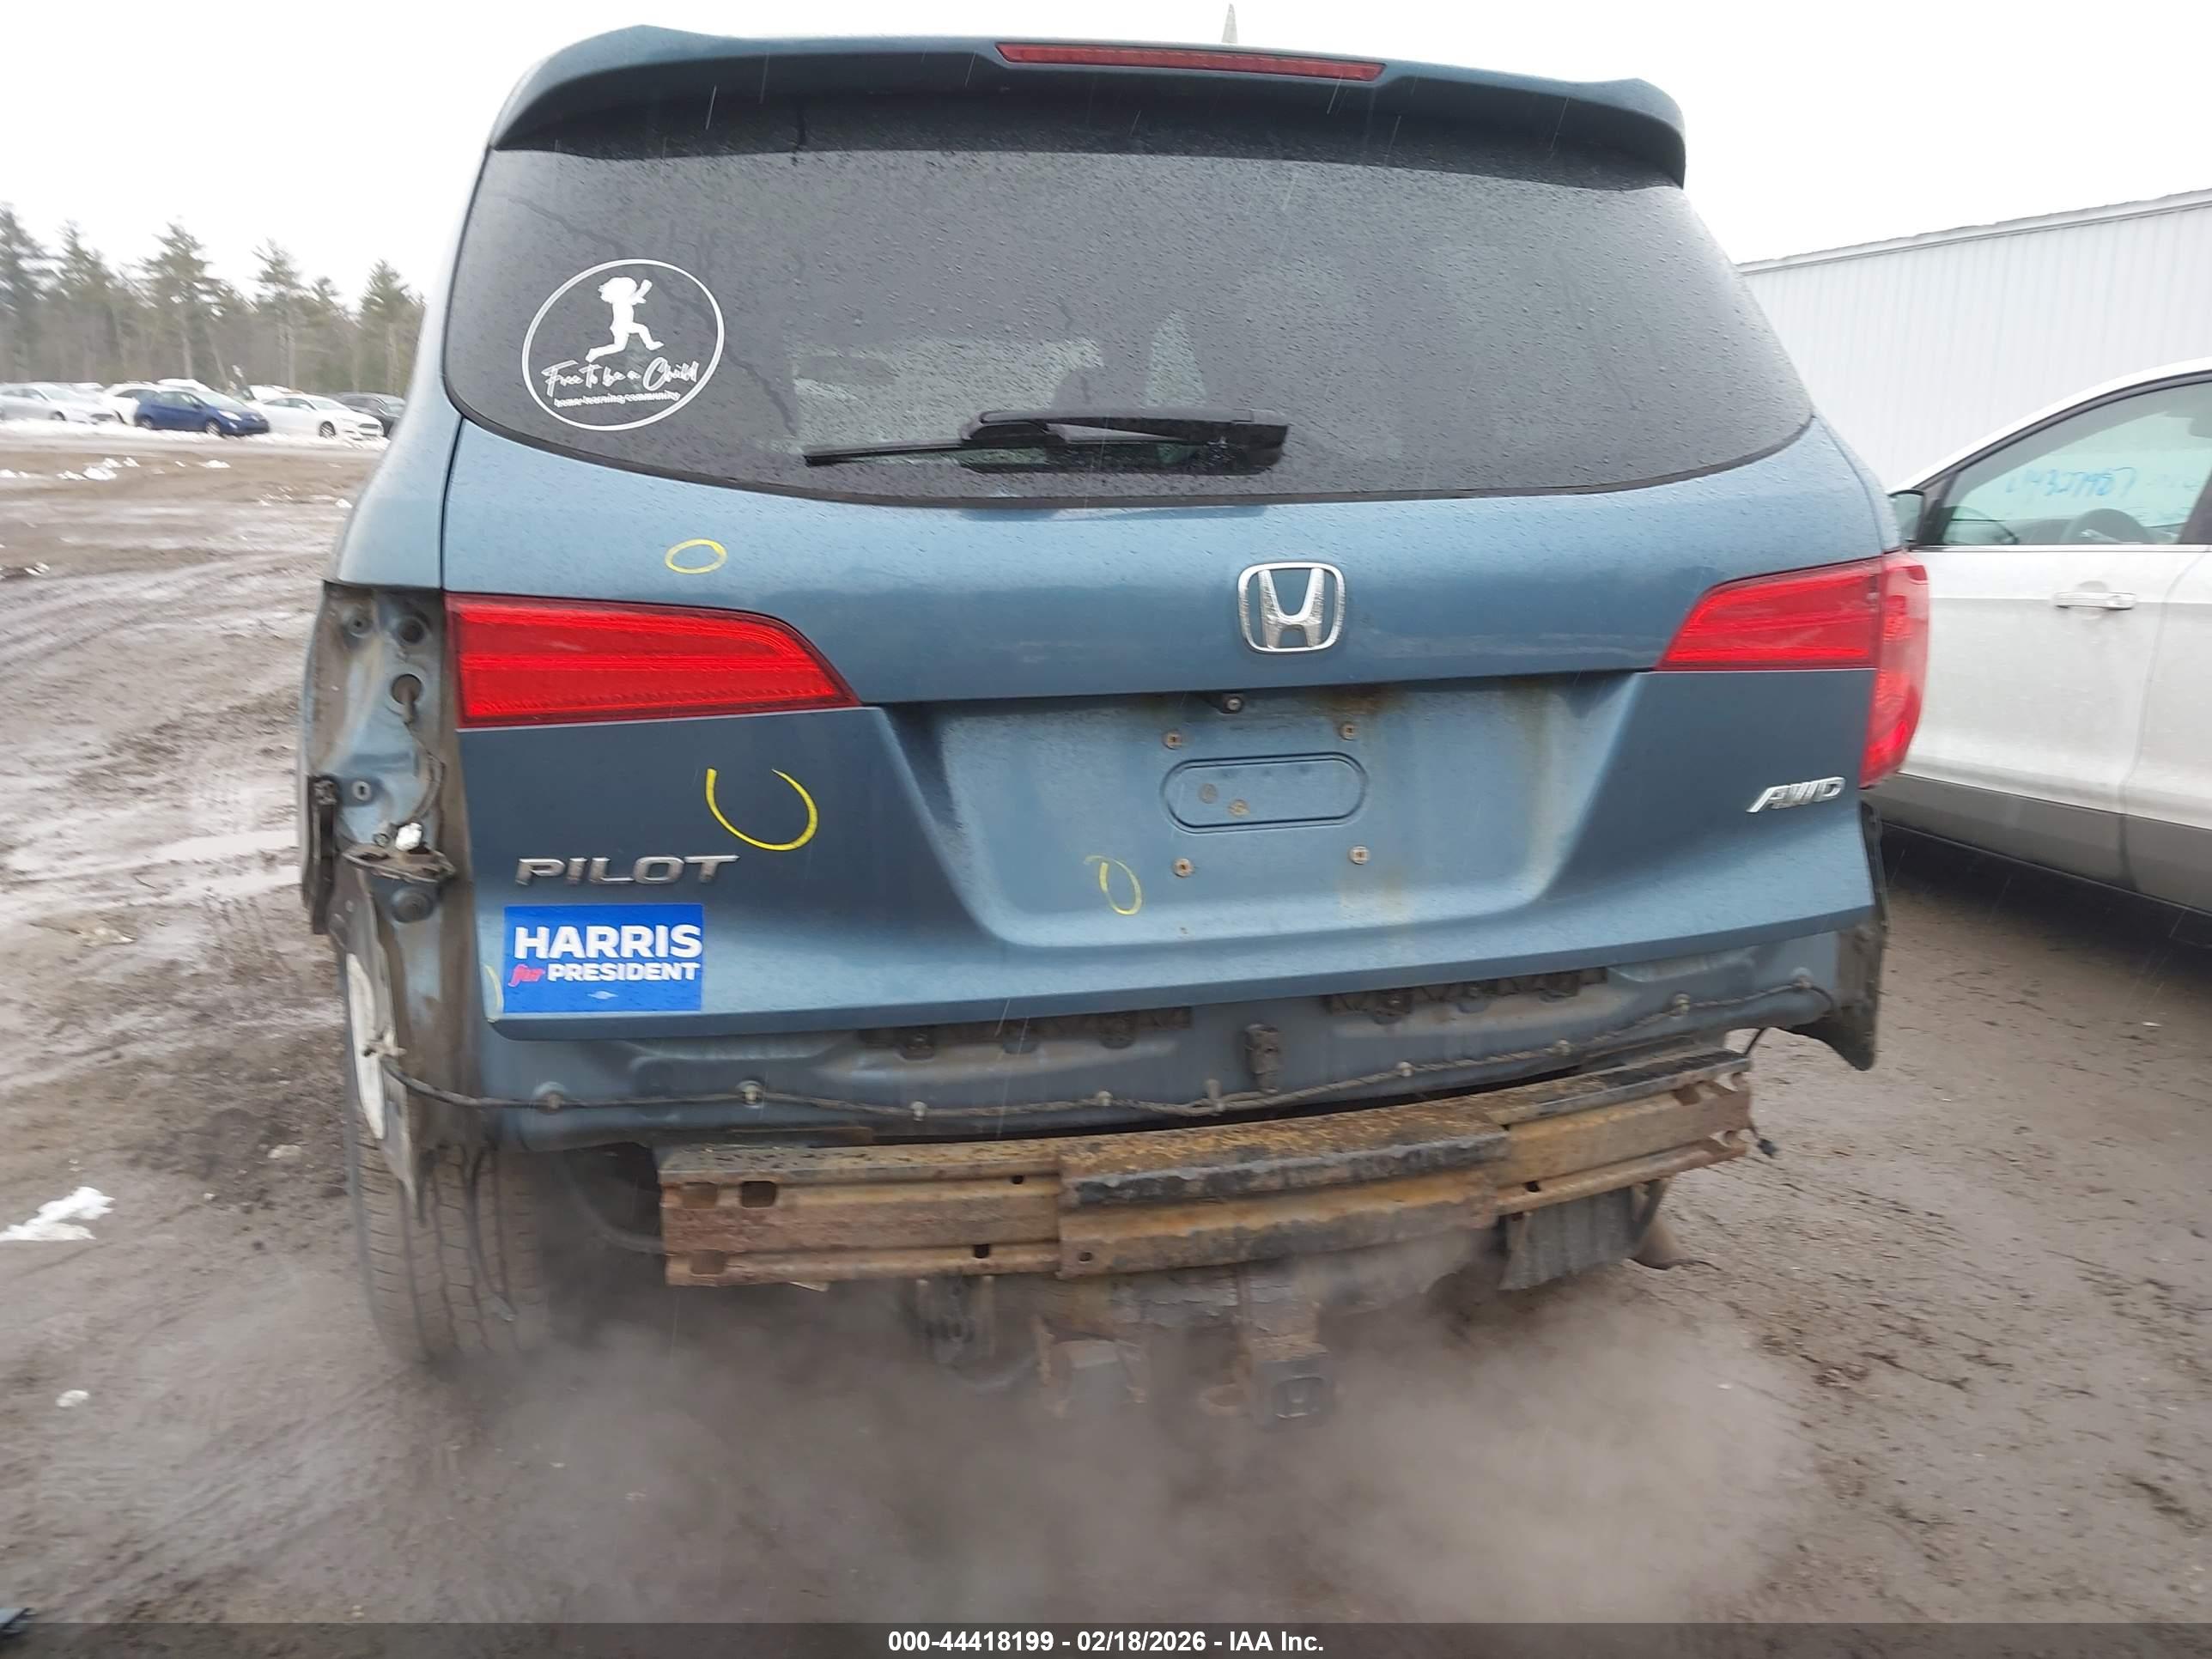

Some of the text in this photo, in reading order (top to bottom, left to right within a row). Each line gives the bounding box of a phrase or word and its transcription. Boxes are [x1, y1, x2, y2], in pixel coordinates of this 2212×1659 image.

[541, 356, 700, 398] Free To be a Child
[1746, 775, 1845, 813] AWD
[515, 854, 740, 886] PILOT
[514, 923, 703, 960] HARRIS
[547, 962, 702, 982] PRESIDENT
